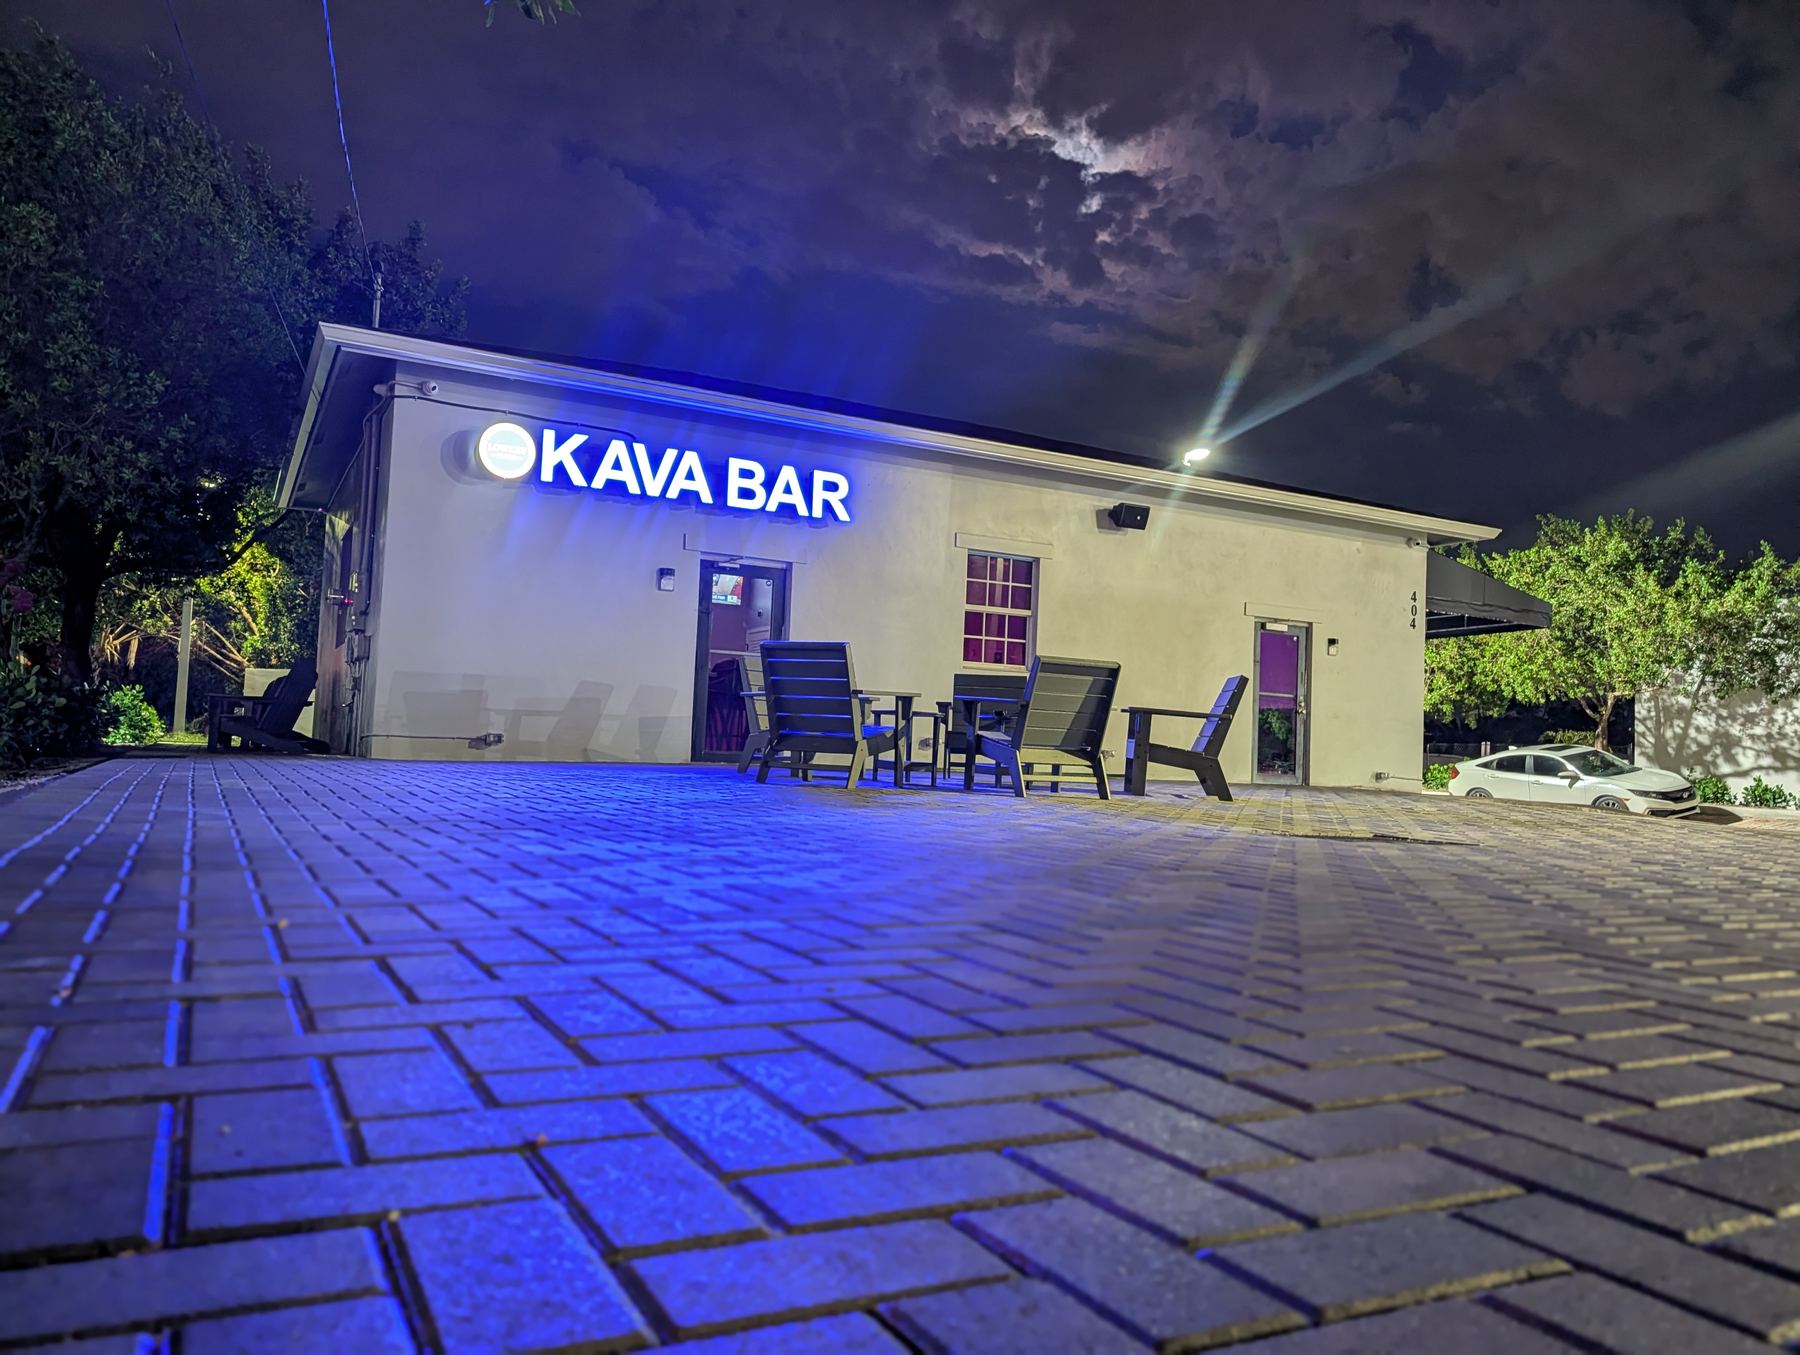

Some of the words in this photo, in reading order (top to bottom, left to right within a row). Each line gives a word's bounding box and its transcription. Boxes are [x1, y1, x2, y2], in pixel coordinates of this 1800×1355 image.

[540, 428, 713, 504] KAVA
[726, 457, 851, 522] BAR
[1409, 590, 1418, 630] 404
